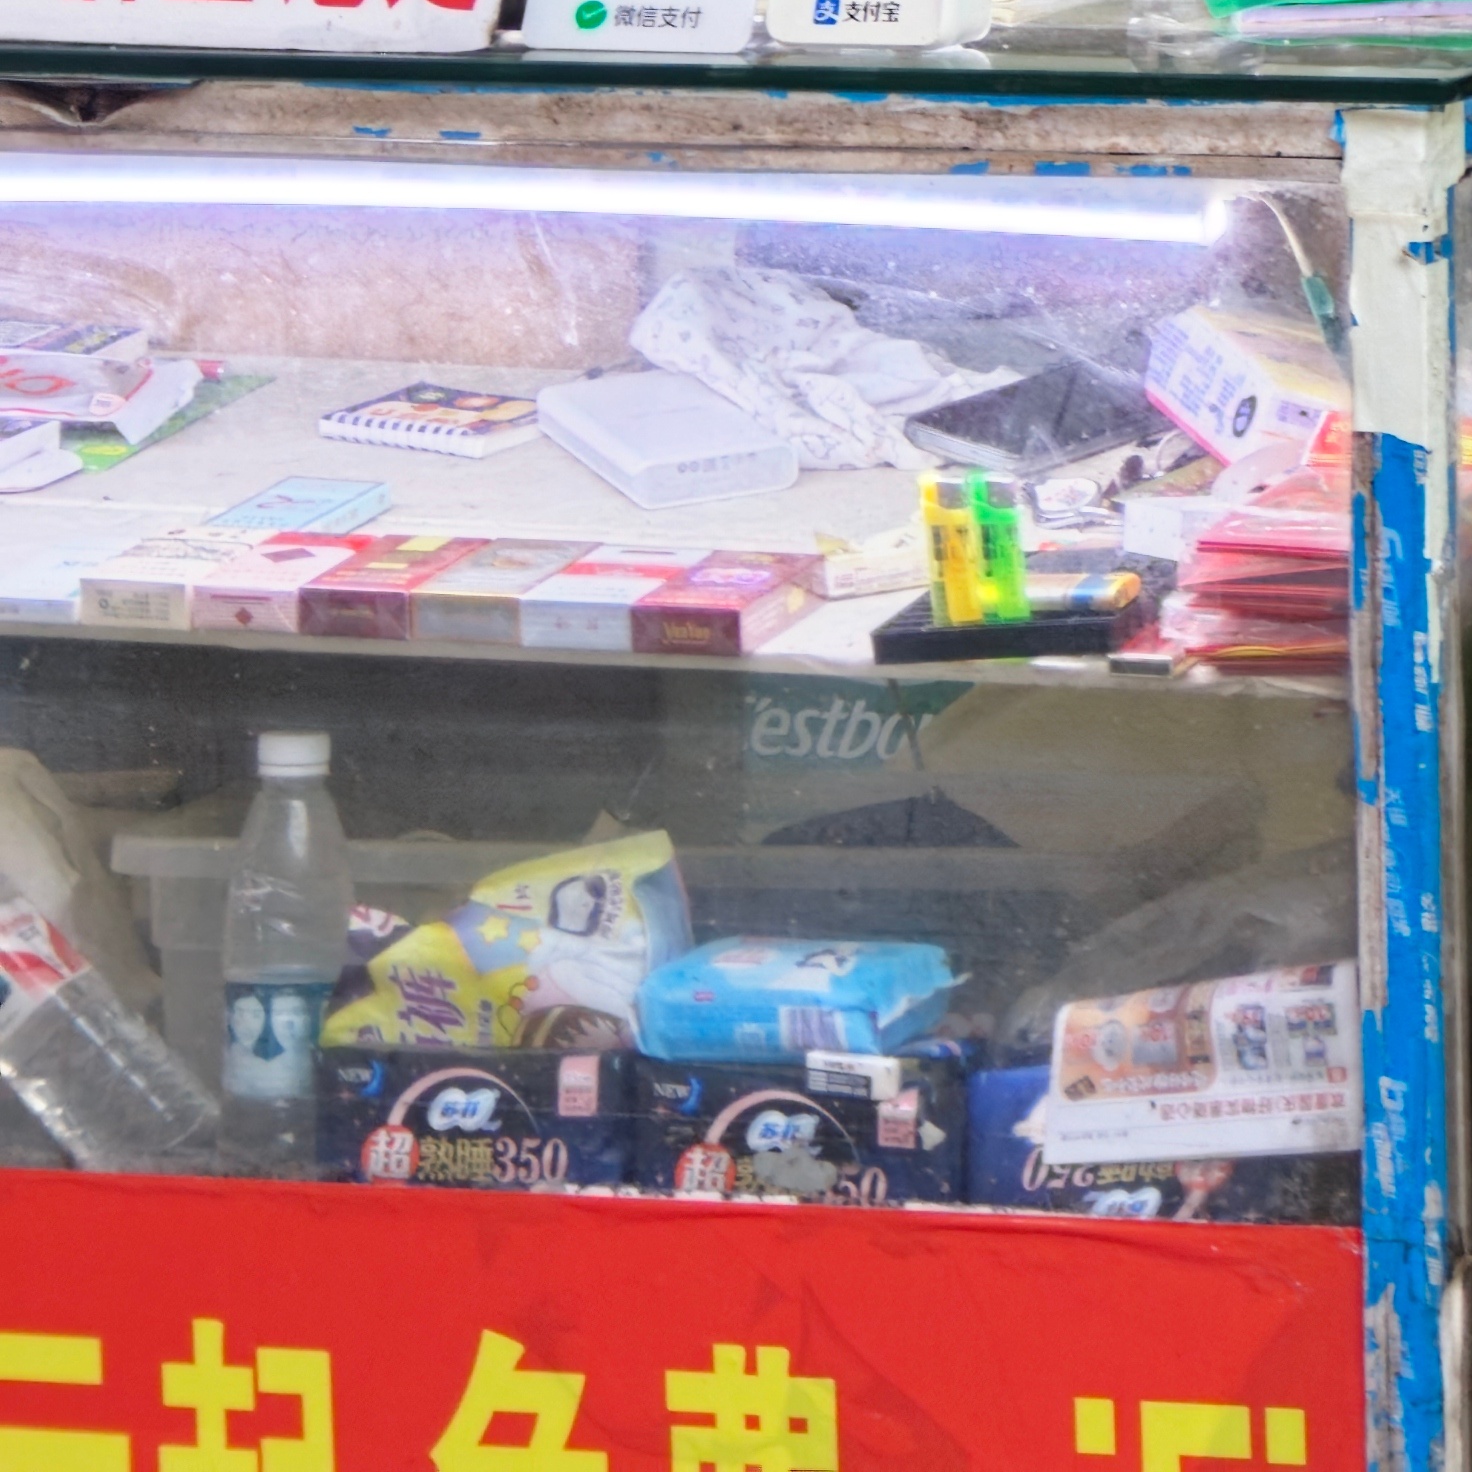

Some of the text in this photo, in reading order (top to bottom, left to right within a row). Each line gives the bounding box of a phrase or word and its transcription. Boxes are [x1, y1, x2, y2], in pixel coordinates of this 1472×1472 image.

[613, 3, 703, 29] 微信支付
[844, 0, 901, 24] 支付宝
